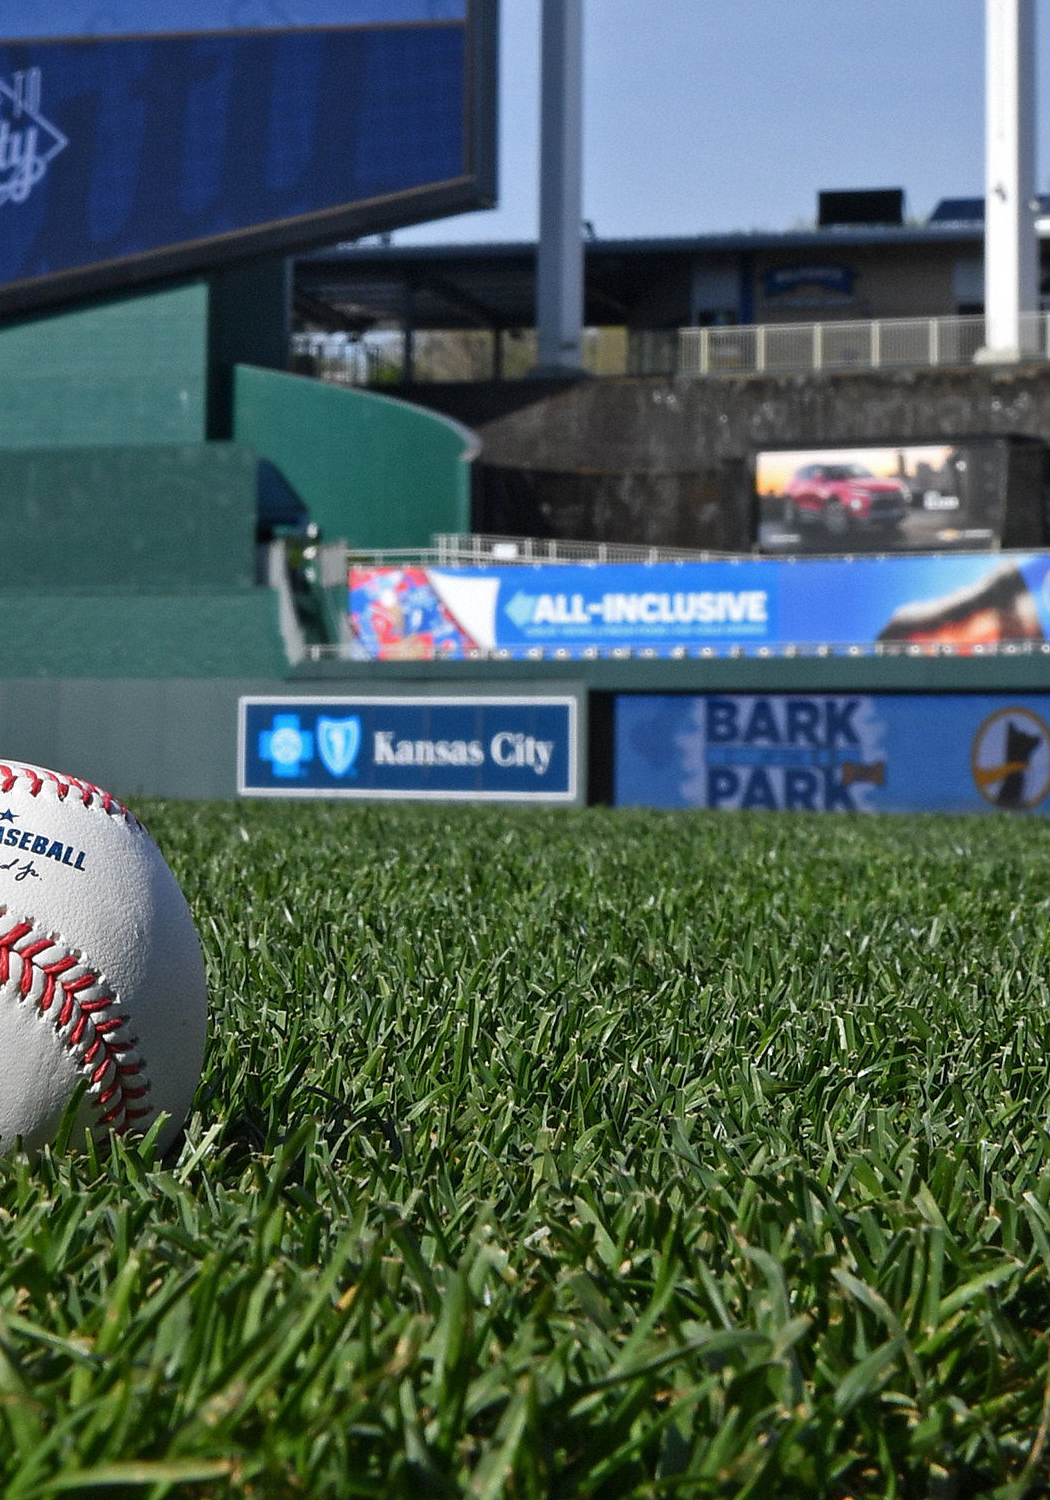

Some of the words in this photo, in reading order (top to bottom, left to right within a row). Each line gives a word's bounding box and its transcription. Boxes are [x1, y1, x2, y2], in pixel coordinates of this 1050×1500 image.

[532, 591, 768, 624] ALL-INCLUSIVE
[706, 698, 861, 743] BARK
[373, 730, 486, 767] Kansas
[490, 731, 553, 776] City
[706, 767, 859, 811] PARK
